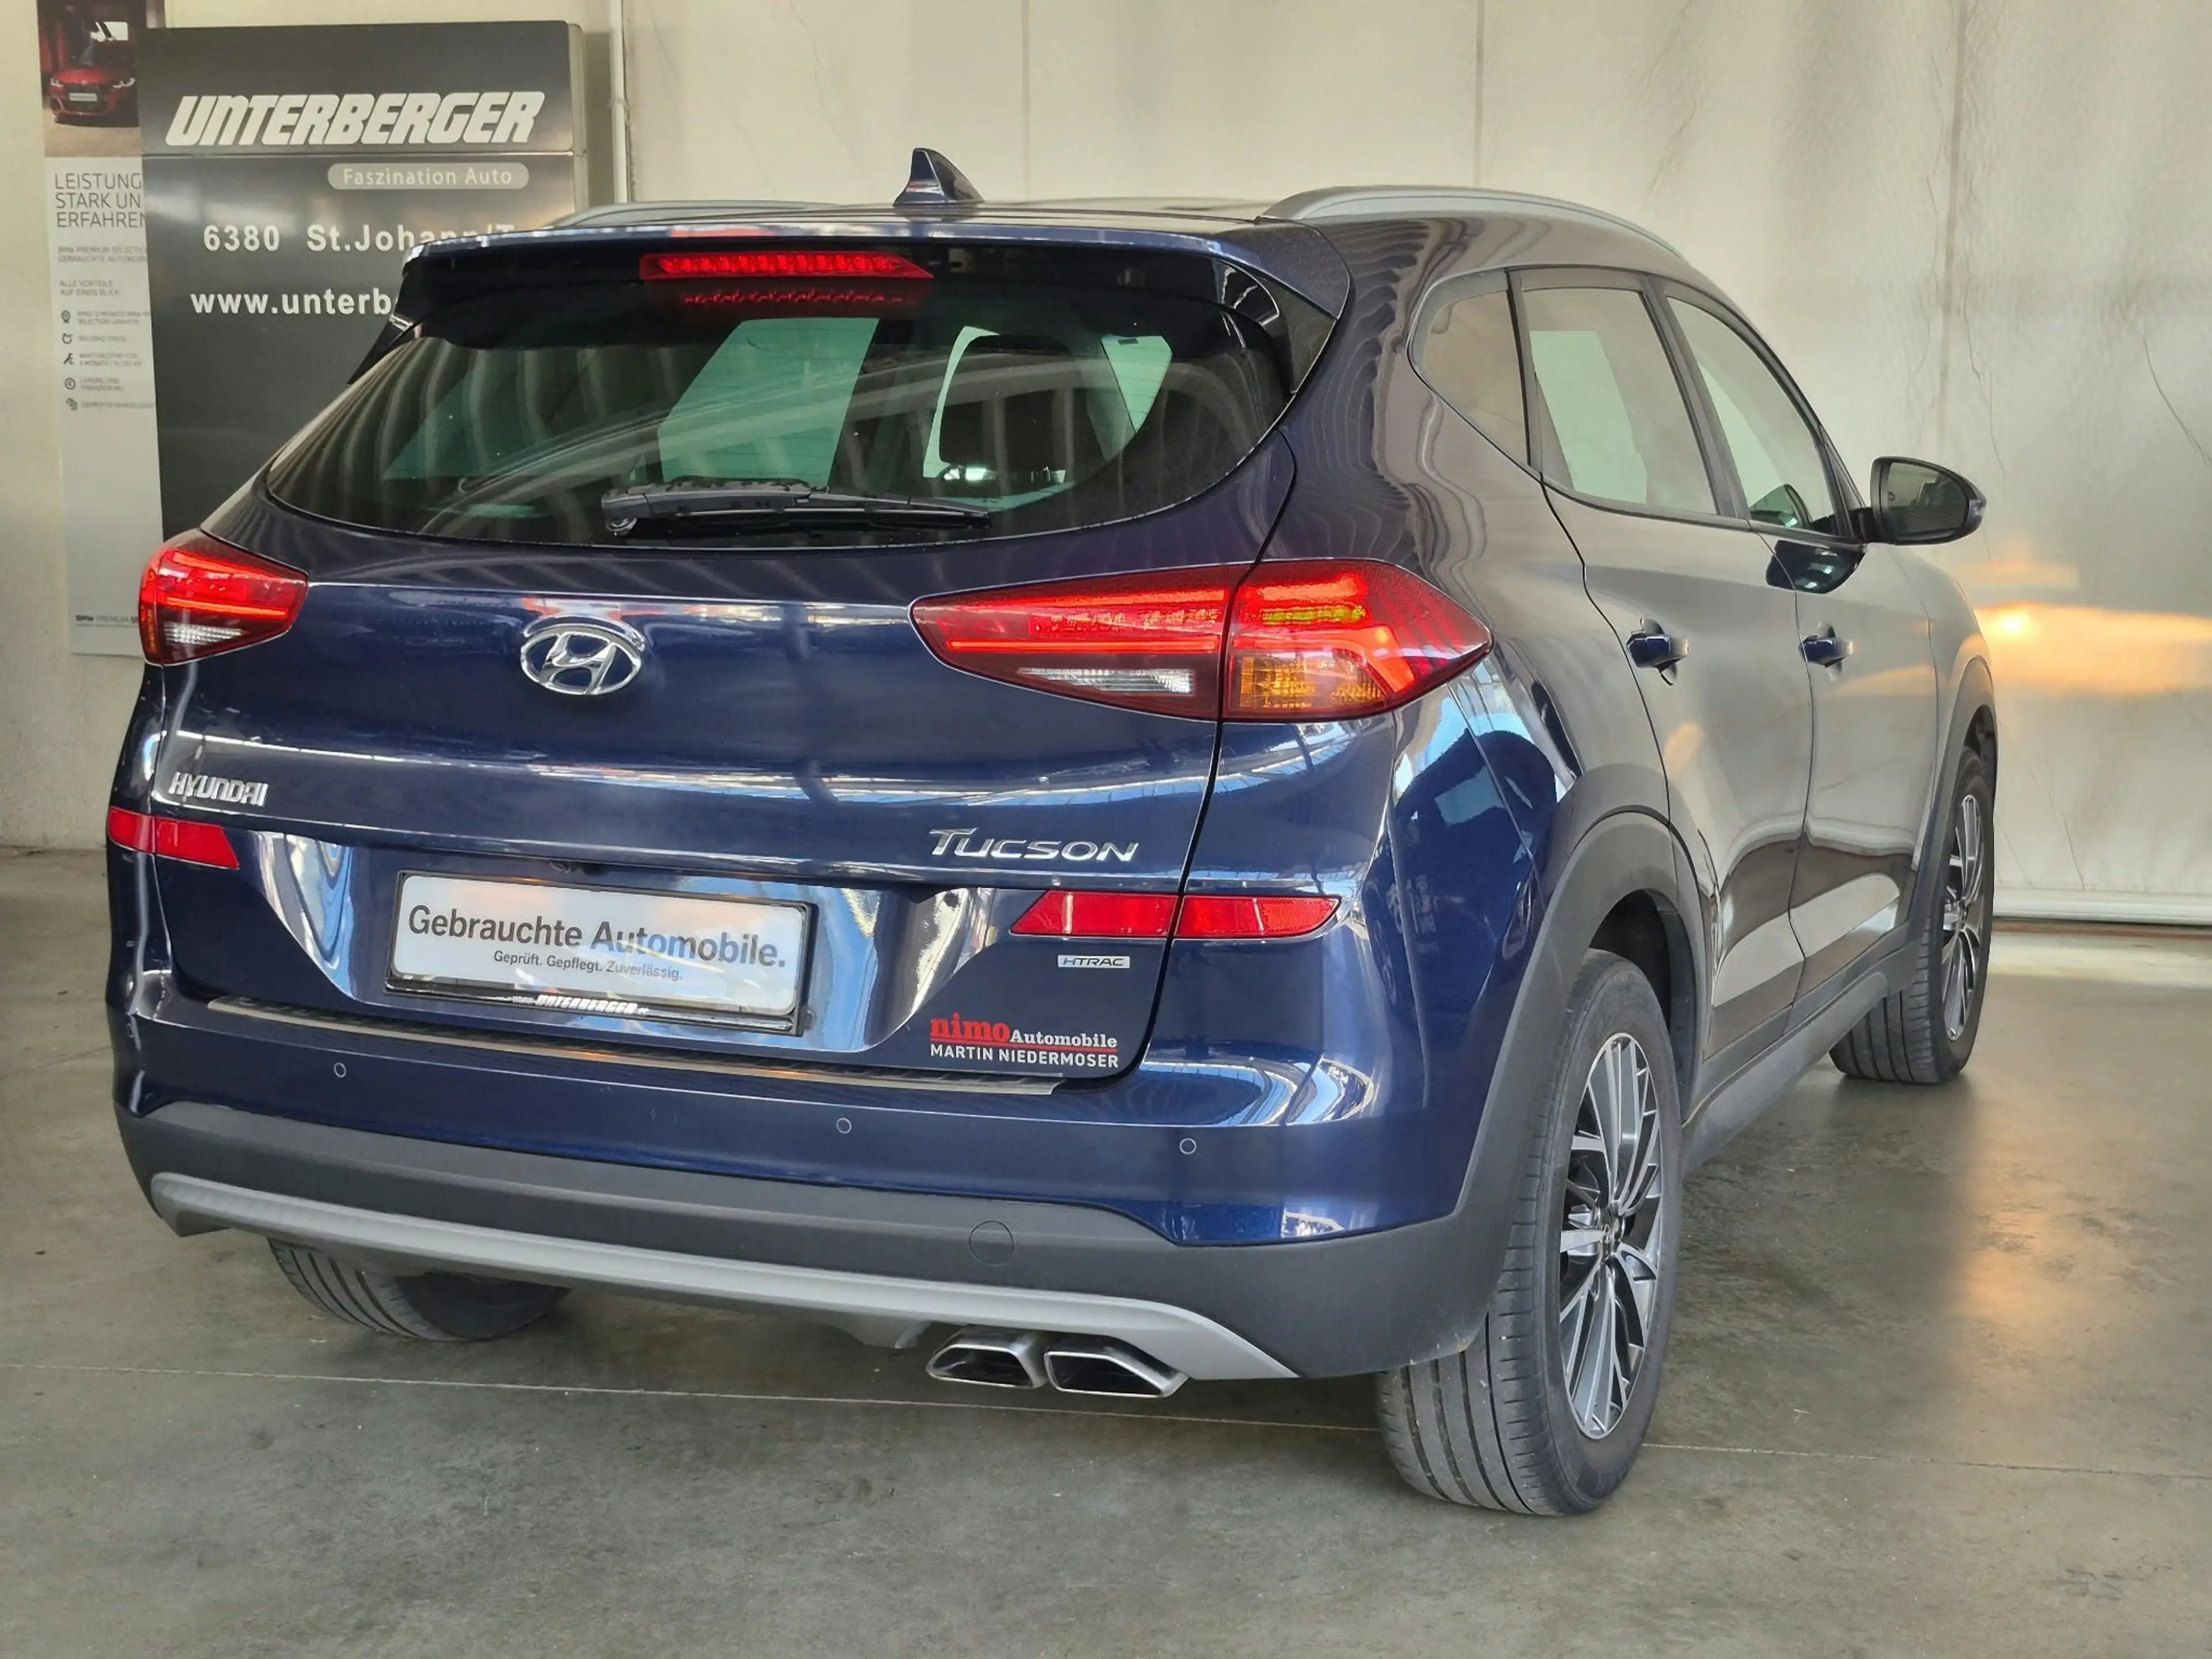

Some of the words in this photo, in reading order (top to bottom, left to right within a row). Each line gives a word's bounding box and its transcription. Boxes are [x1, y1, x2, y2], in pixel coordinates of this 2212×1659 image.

[166, 91, 545, 146] UNTERBERGER
[55, 173, 142, 190] LEISTUNG
[344, 168, 457, 185] Faszination
[465, 168, 512, 185] Auto
[55, 192, 112, 209] STARK
[203, 225, 280, 251] 6380
[190, 287, 398, 315] www.unterb
[168, 771, 268, 806] HYUNDAI
[929, 828, 1139, 862] TUCSON
[408, 904, 583, 948] Gebrauchte
[590, 922, 786, 969] Automobile.
[494, 950, 543, 966] Geprüft.
[547, 955, 603, 974] Gepflegt.
[606, 961, 683, 981] Zuverlässig.
[1063, 957, 1124, 966] HTRAC
[929, 1013, 1010, 1043] nimo
[1010, 1029, 1118, 1048] Automobile
[930, 1044, 993, 1061] MARTIN
[998, 1049, 1119, 1068] NIEDERMOSER
